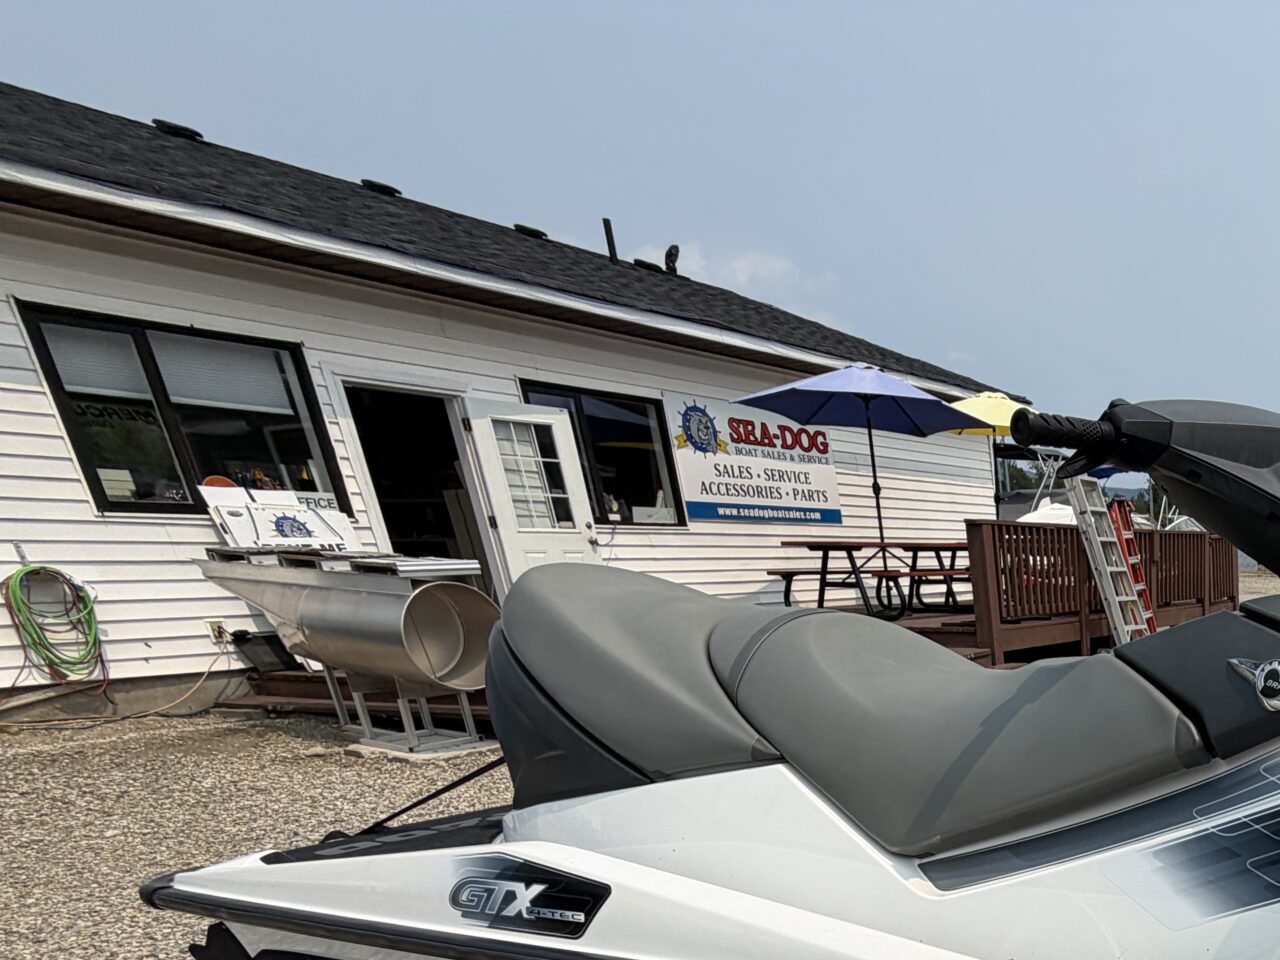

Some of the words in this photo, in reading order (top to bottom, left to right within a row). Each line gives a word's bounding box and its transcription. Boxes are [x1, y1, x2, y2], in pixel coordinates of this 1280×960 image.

[727, 416, 829, 455] SEA-DOG
[734, 446, 759, 458] BOAT
[761, 449, 787, 461] SALES
[789, 453, 795, 462] &
[797, 455, 830, 466] SERVICE
[713, 463, 753, 480] SALES
[764, 468, 812, 485] SERVICE
[700, 481, 782, 500] ACCESSORIES
[793, 488, 829, 503] PARTS
[297, 497, 337, 510] FFICE
[717, 506, 821, 520] www.seadogboatsales.com
[450, 876, 549, 921] GTX
